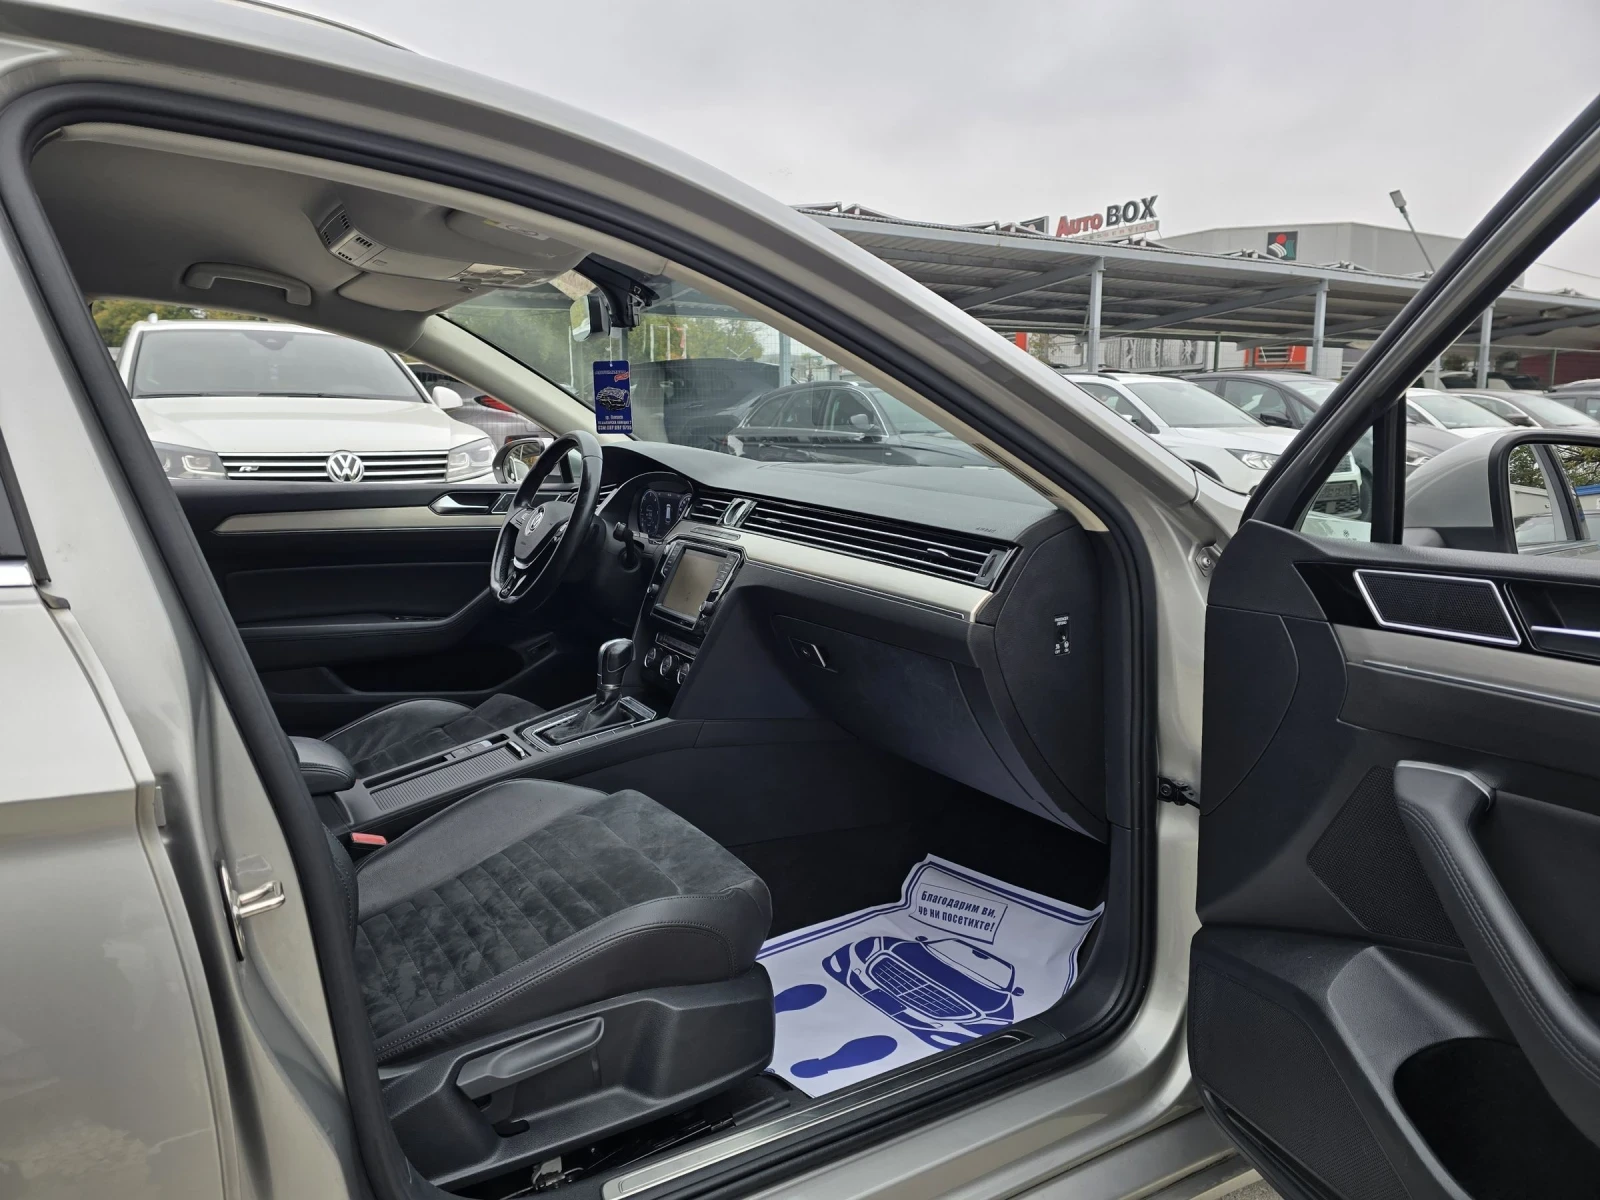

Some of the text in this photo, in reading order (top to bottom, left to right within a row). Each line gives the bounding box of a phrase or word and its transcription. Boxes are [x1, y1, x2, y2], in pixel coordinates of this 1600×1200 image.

[1106, 195, 1158, 227] BOX
[921, 890, 996, 919] Благодарим ви,
[929, 908, 940, 920] ни
[942, 911, 995, 932] посетихте!
